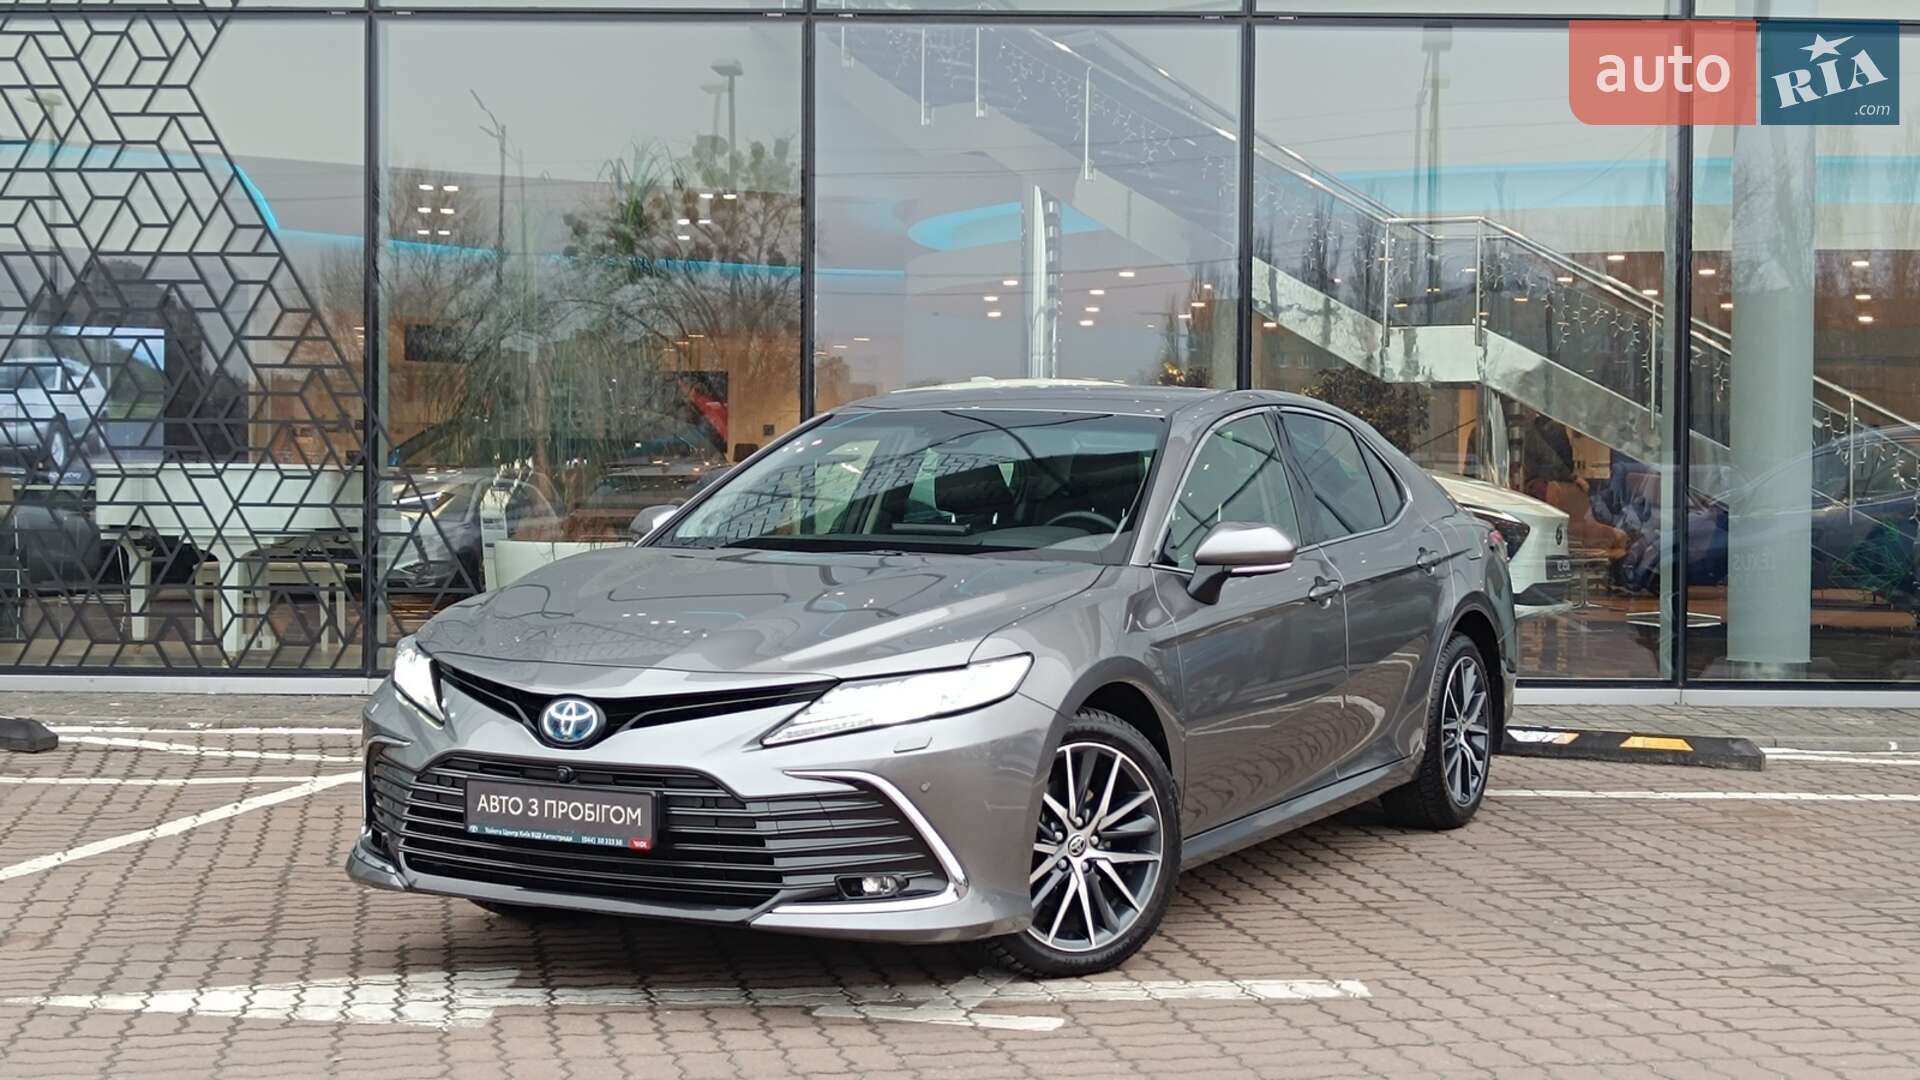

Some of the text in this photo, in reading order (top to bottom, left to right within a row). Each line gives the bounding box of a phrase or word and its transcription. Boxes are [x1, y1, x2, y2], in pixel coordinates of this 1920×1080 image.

[477, 794, 642, 826] АВТО З ПРОБІГОМ
